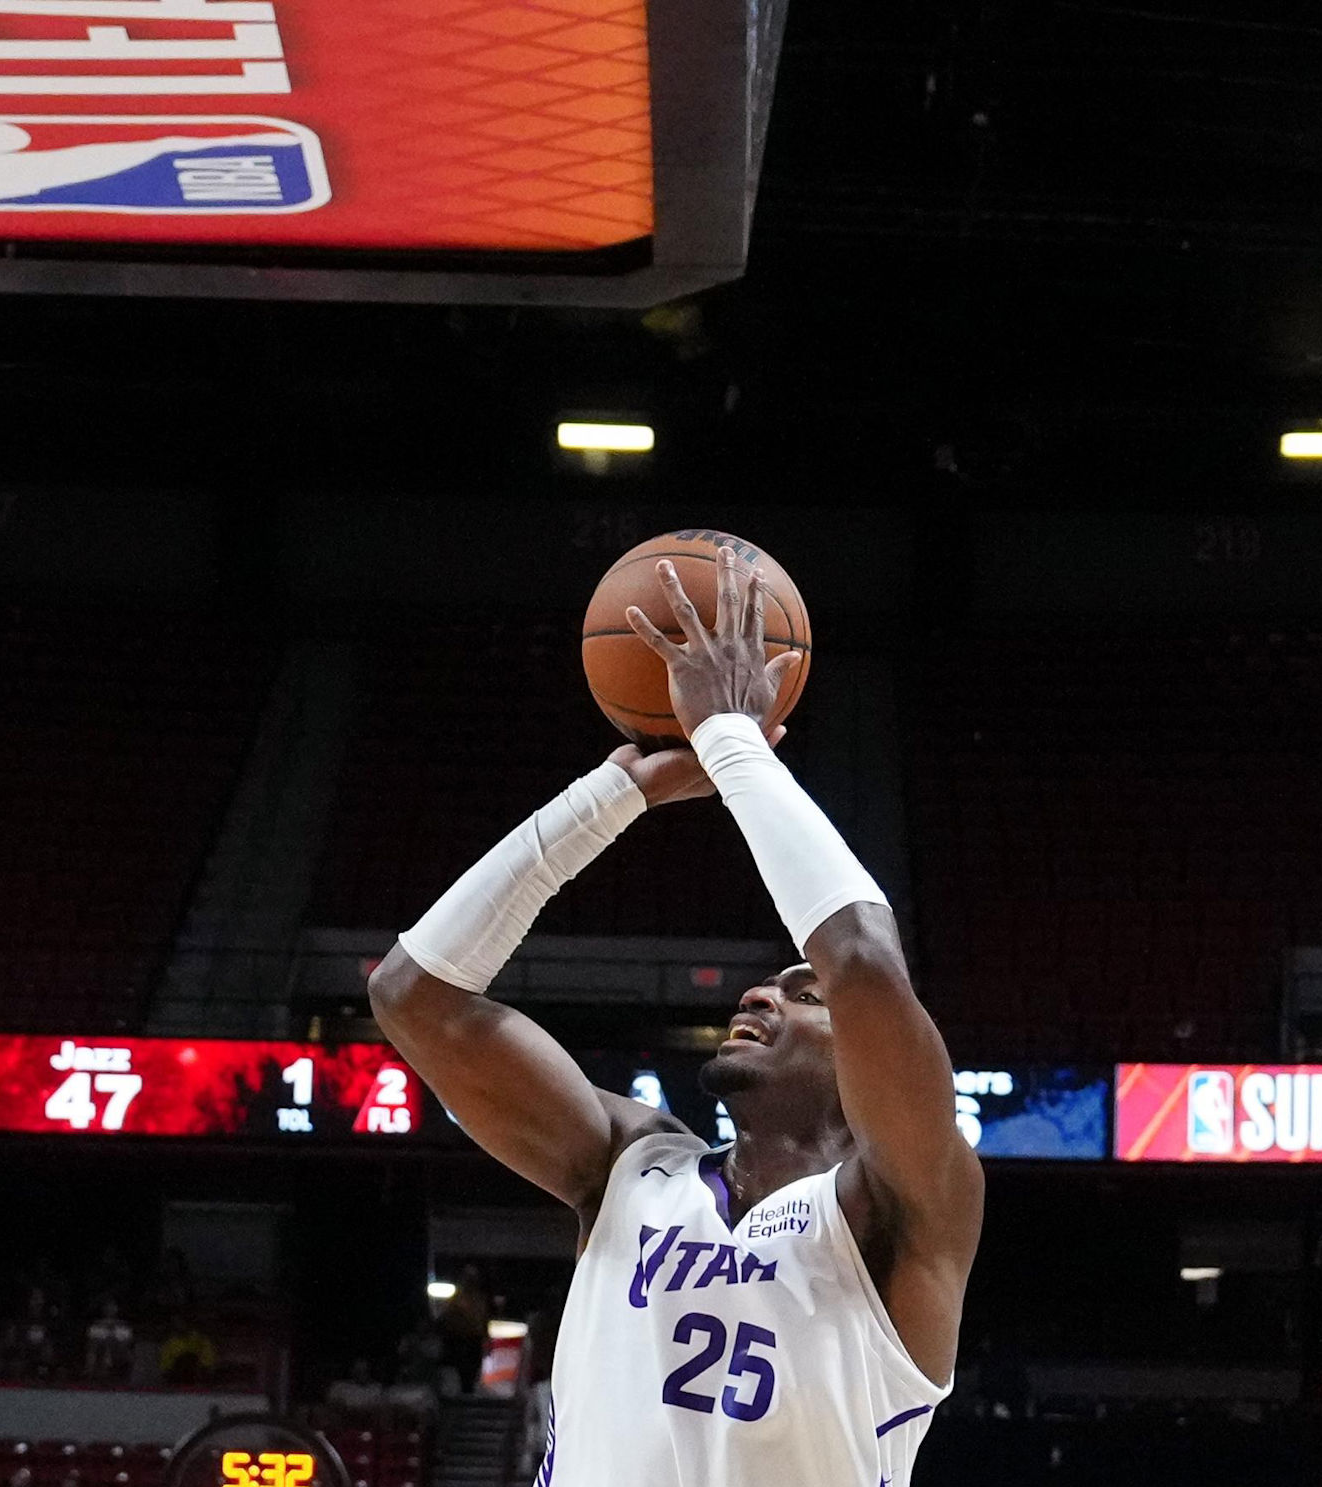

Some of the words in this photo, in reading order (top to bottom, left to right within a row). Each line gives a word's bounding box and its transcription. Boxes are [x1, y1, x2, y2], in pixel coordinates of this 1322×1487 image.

[173, 156, 284, 201] NBA
[44, 1071, 142, 1130] 47
[282, 1057, 313, 1105] 1
[375, 1068, 408, 1105] 2
[747, 1216, 810, 1240] Equity
[749, 1199, 811, 1224] Health
[628, 1224, 778, 1308] UTAH
[662, 1312, 777, 1422] 25
